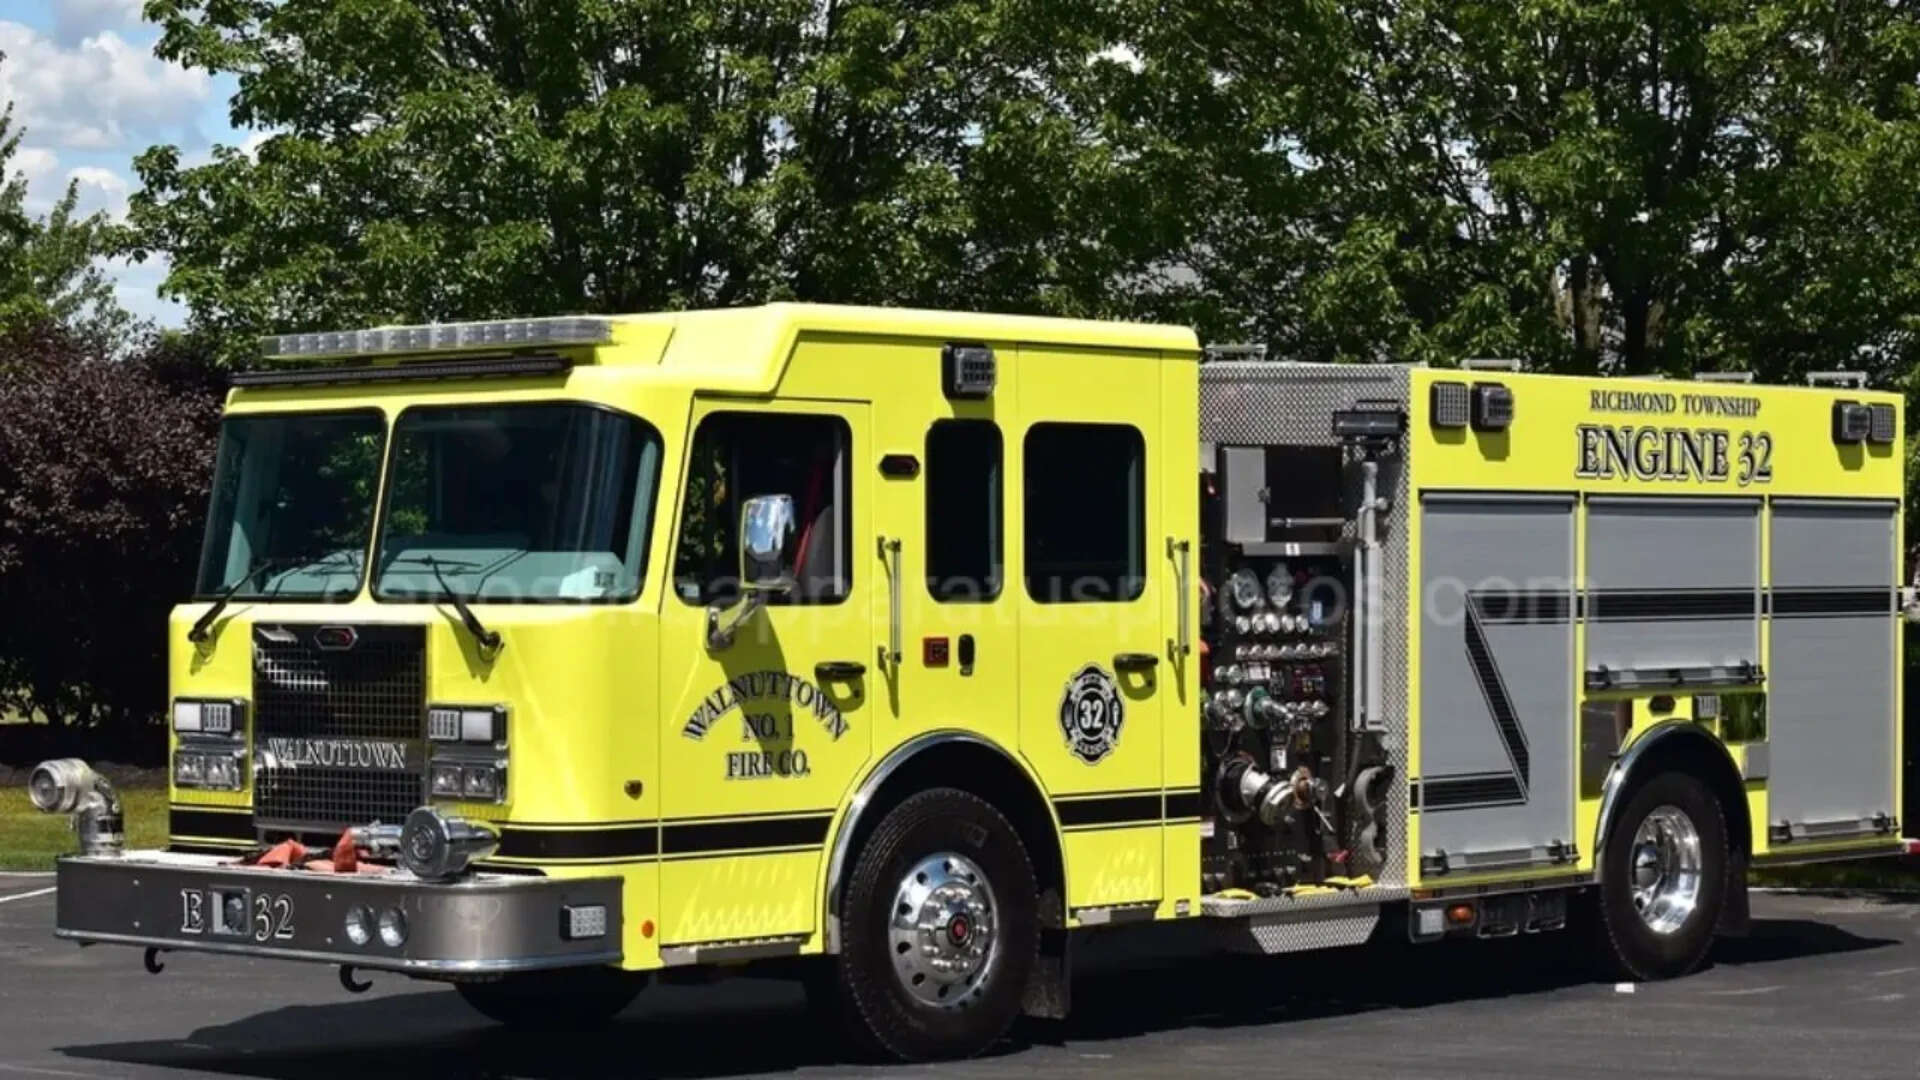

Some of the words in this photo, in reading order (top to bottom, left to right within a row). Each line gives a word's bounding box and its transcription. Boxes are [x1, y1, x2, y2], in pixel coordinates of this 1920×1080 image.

[1590, 389, 1677, 415] RICHMOND
[1683, 393, 1762, 418] TOWNSHIP
[1575, 423, 1730, 482] ENGINE
[1738, 430, 1774, 488] 32
[682, 671, 851, 743] WALNUTTOWN
[1080, 699, 1105, 729] 32
[743, 712, 780, 742] NO.
[267, 737, 409, 769] WALNUTTOWN
[725, 751, 773, 780] FIRE
[777, 748, 812, 779] CO.
[180, 887, 204, 934] E
[255, 892, 295, 942] 32
